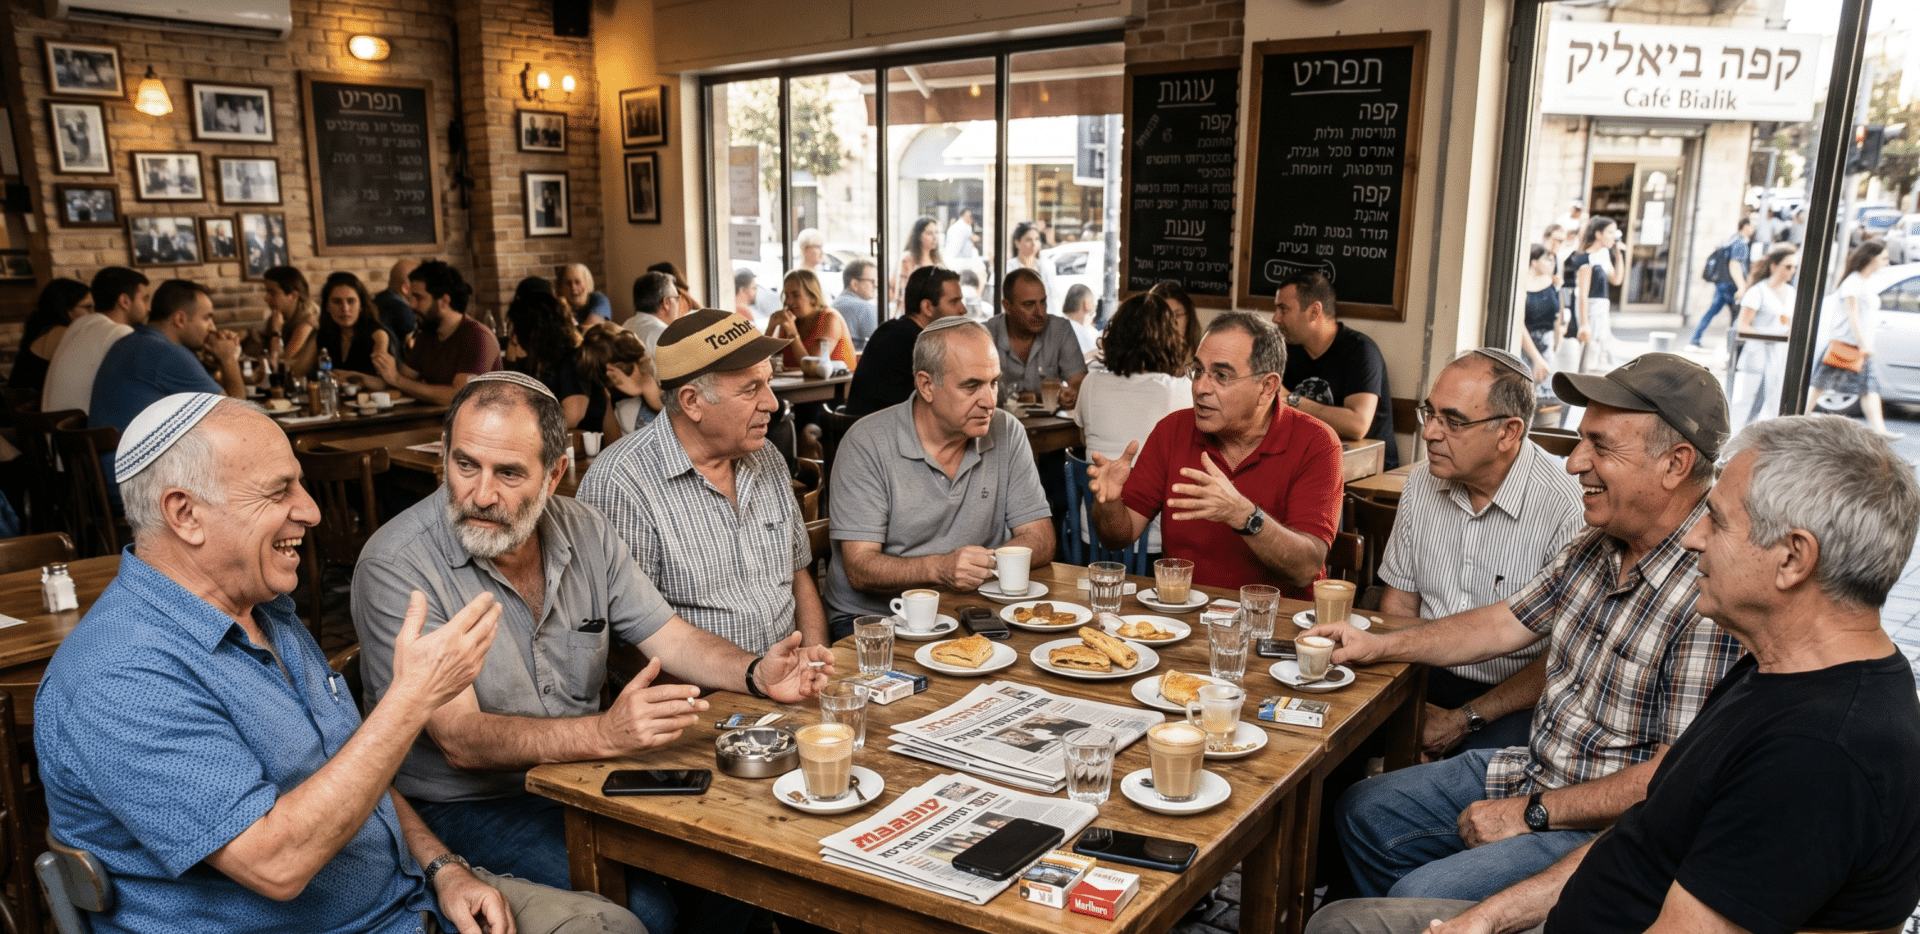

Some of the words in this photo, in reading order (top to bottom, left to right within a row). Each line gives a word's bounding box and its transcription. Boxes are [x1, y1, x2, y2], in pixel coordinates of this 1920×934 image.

[1567, 30, 1702, 84] ביאליק
[1720, 45, 1802, 91] קפה
[1293, 58, 1383, 86] תפריט
[338, 89, 402, 112] תפריט
[1157, 78, 1214, 103] עוגות
[1623, 86, 1671, 108] Café
[1679, 88, 1738, 111] Bialik
[1200, 114, 1232, 134] קפה
[1359, 103, 1398, 126] קפה
[1353, 185, 1391, 208] קפה
